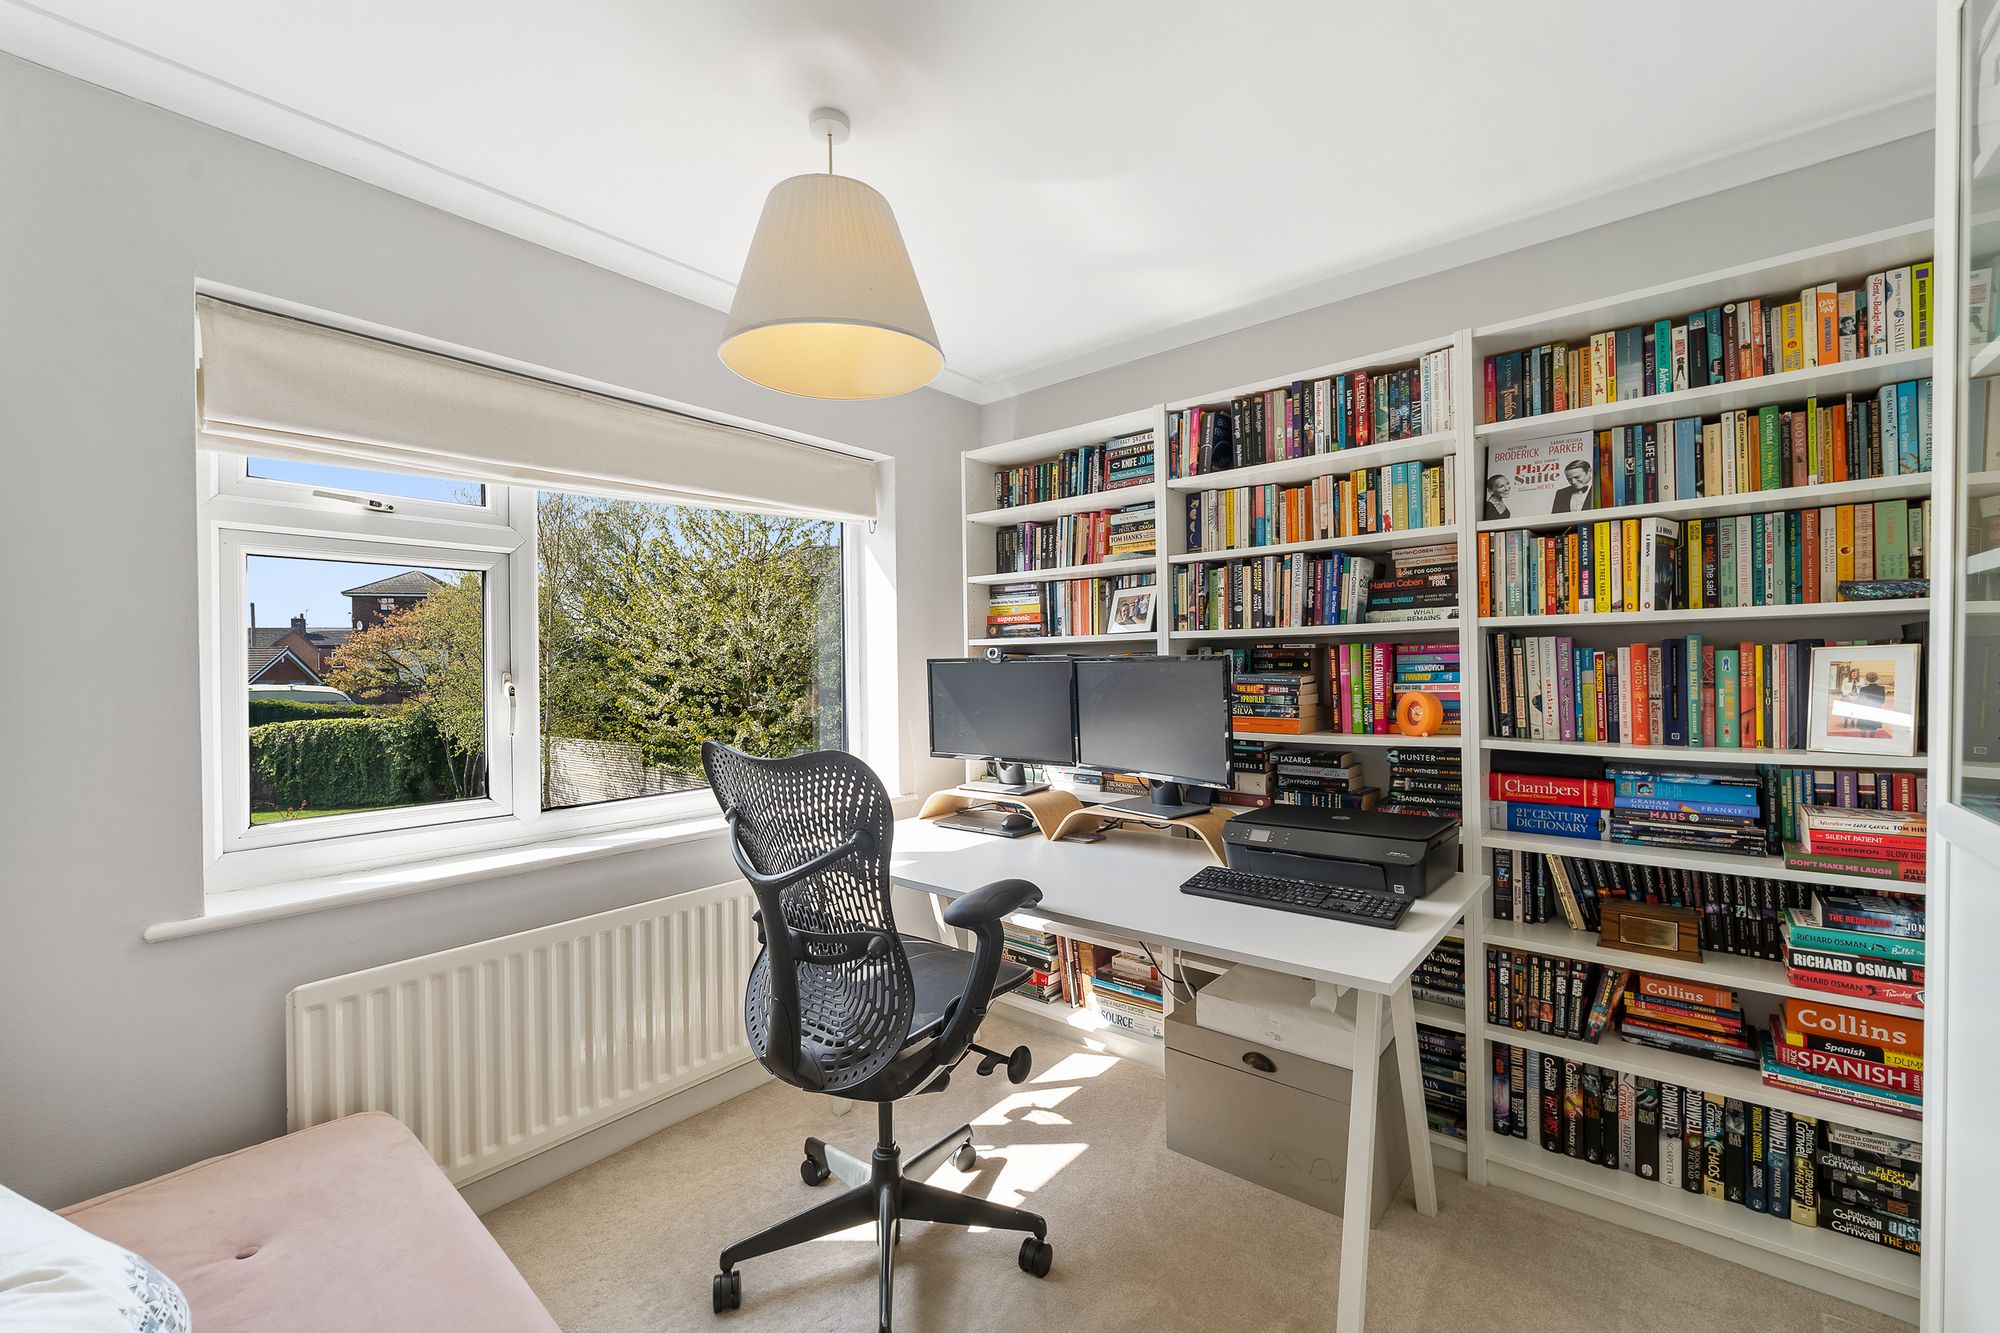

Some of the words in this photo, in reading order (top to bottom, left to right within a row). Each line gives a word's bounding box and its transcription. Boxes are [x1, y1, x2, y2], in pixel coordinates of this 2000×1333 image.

[1645, 353, 1653, 375] LEON
[1766, 414, 1775, 445] Curtains
[1795, 416, 1805, 452] ROOMS
[1494, 448, 1540, 462] BRODERICK
[1548, 442, 1584, 456] PARKER
[1644, 441, 1655, 458] LIFE
[1122, 458, 1137, 468] KNIFE
[1515, 462, 1560, 475] Plaza
[1513, 472, 1561, 486] Suite
[1706, 534, 1715, 544] he
[1707, 547, 1715, 563] said
[1722, 544, 1732, 559] Nina
[1294, 555, 1302, 579] ORPHAN
[1399, 568, 1413, 576] GONE
[1426, 566, 1442, 574] GOOD
[1707, 564, 1715, 578] she
[1370, 580, 1395, 590] Harlan
[1396, 579, 1423, 587] Coben
[1707, 580, 1716, 596] said
[1364, 648, 1372, 667] JANET
[1374, 647, 1383, 666] JANET
[1634, 660, 1642, 690] NORTON
[1364, 669, 1372, 705] EVANOVICH
[1375, 666, 1384, 700] EVANOVICH
[1232, 707, 1254, 715] SILVA
[1280, 756, 1312, 764] LAZARUS
[1400, 753, 1436, 762] HUNTER
[1413, 767, 1438, 775] WITNESS
[1288, 778, 1320, 786] HYPNOTIST
[1411, 782, 1442, 790] STALKER
[1505, 779, 1580, 796] Chambers
[1401, 796, 1436, 804] SANDMAN
[1631, 798, 1670, 806] GRAHAM
[1532, 809, 1588, 823] CENTURY
[1650, 811, 1686, 820] MAUS
[1701, 805, 1744, 814] FRANKIE
[1516, 817, 1588, 832] DICTIONARY
[1825, 833, 1851, 841] SILENT
[1853, 835, 1884, 844] PATIENT
[1841, 847, 1880, 856] HERRON
[1885, 850, 1909, 858] SLOW
[1790, 859, 1818, 868] DON'T
[1818, 861, 1844, 870] MAKE
[1845, 864, 1859, 872] ME
[1860, 865, 1892, 875] LAUGH
[1829, 913, 1843, 922] THE
[1845, 916, 1892, 928] REDBREAST
[1905, 923, 1916, 931] JO
[1834, 938, 1867, 949] OSMAN
[1892, 946, 1916, 956] Bullet
[1440, 955, 1460, 965] Noose
[1855, 962, 1907, 981] OSMAN
[1420, 988, 1428, 999] P
[1647, 983, 1704, 1003] Collins
[1830, 981, 1863, 991] OSMAN
[1882, 989, 1912, 999] Thursday
[1646, 996, 1665, 1006] SHORT
[1666, 1000, 1689, 1008] STORIES
[1646, 1003, 1666, 1012] SHORT
[1666, 1006, 1690, 1016] STORIES
[1693, 1004, 1716, 1014] SPANISH
[1100, 1010, 1134, 1029] SOURCE
[1694, 1012, 1717, 1022] SPANISH
[1798, 1009, 1907, 1045] Collins
[1825, 1042, 1866, 1058] Spanish
[1544, 1057, 1554, 1091] Cornwell
[1798, 1051, 1907, 1088] SPANISH
[1512, 1066, 1524, 1093] CORNWELL
[1565, 1063, 1577, 1097] Cornwell
[1619, 1084, 1629, 1120] Cornwell
[1662, 1083, 1678, 1130] CORNWELL
[1818, 1090, 1852, 1102] Intermediate
[1853, 1098, 1875, 1107] Spanish
[1876, 1102, 1902, 1112] Grammar
[1686, 1089, 1701, 1134] CORNWELL
[1753, 1107, 1762, 1131] PATRICIA
[1705, 1103, 1717, 1136] Cornwell
[1568, 1122, 1576, 1146] Mortuary
[1623, 1124, 1632, 1159] AUTOPSY
[1795, 1121, 1808, 1158] Cornwell
[1805, 1129, 1814, 1154] Patricia
[1839, 1133, 1861, 1142] PATRICIA
[1862, 1137, 1891, 1147] CORNWELL
[1753, 1132, 1762, 1162] CORNWELL
[1833, 1137, 1855, 1146] PATRICIA
[1857, 1141, 1887, 1153] CORNWELL
[1708, 1145, 1720, 1178] CHAOS
[1822, 1156, 1866, 1176] Cornwell
[1828, 1153, 1859, 1166] Patricia
[1876, 1167, 1905, 1178] FLESH
[1880, 1173, 1912, 1187] BLOOD
[1794, 1171, 1804, 1199] HEART
[1804, 1169, 1813, 1205] DEPRAVED
[1833, 1208, 1882, 1230] Cornwell
[1848, 1209, 1877, 1222] Patricia
[1832, 1220, 1880, 1242] Cornwell
[1882, 1234, 1902, 1248] THE
